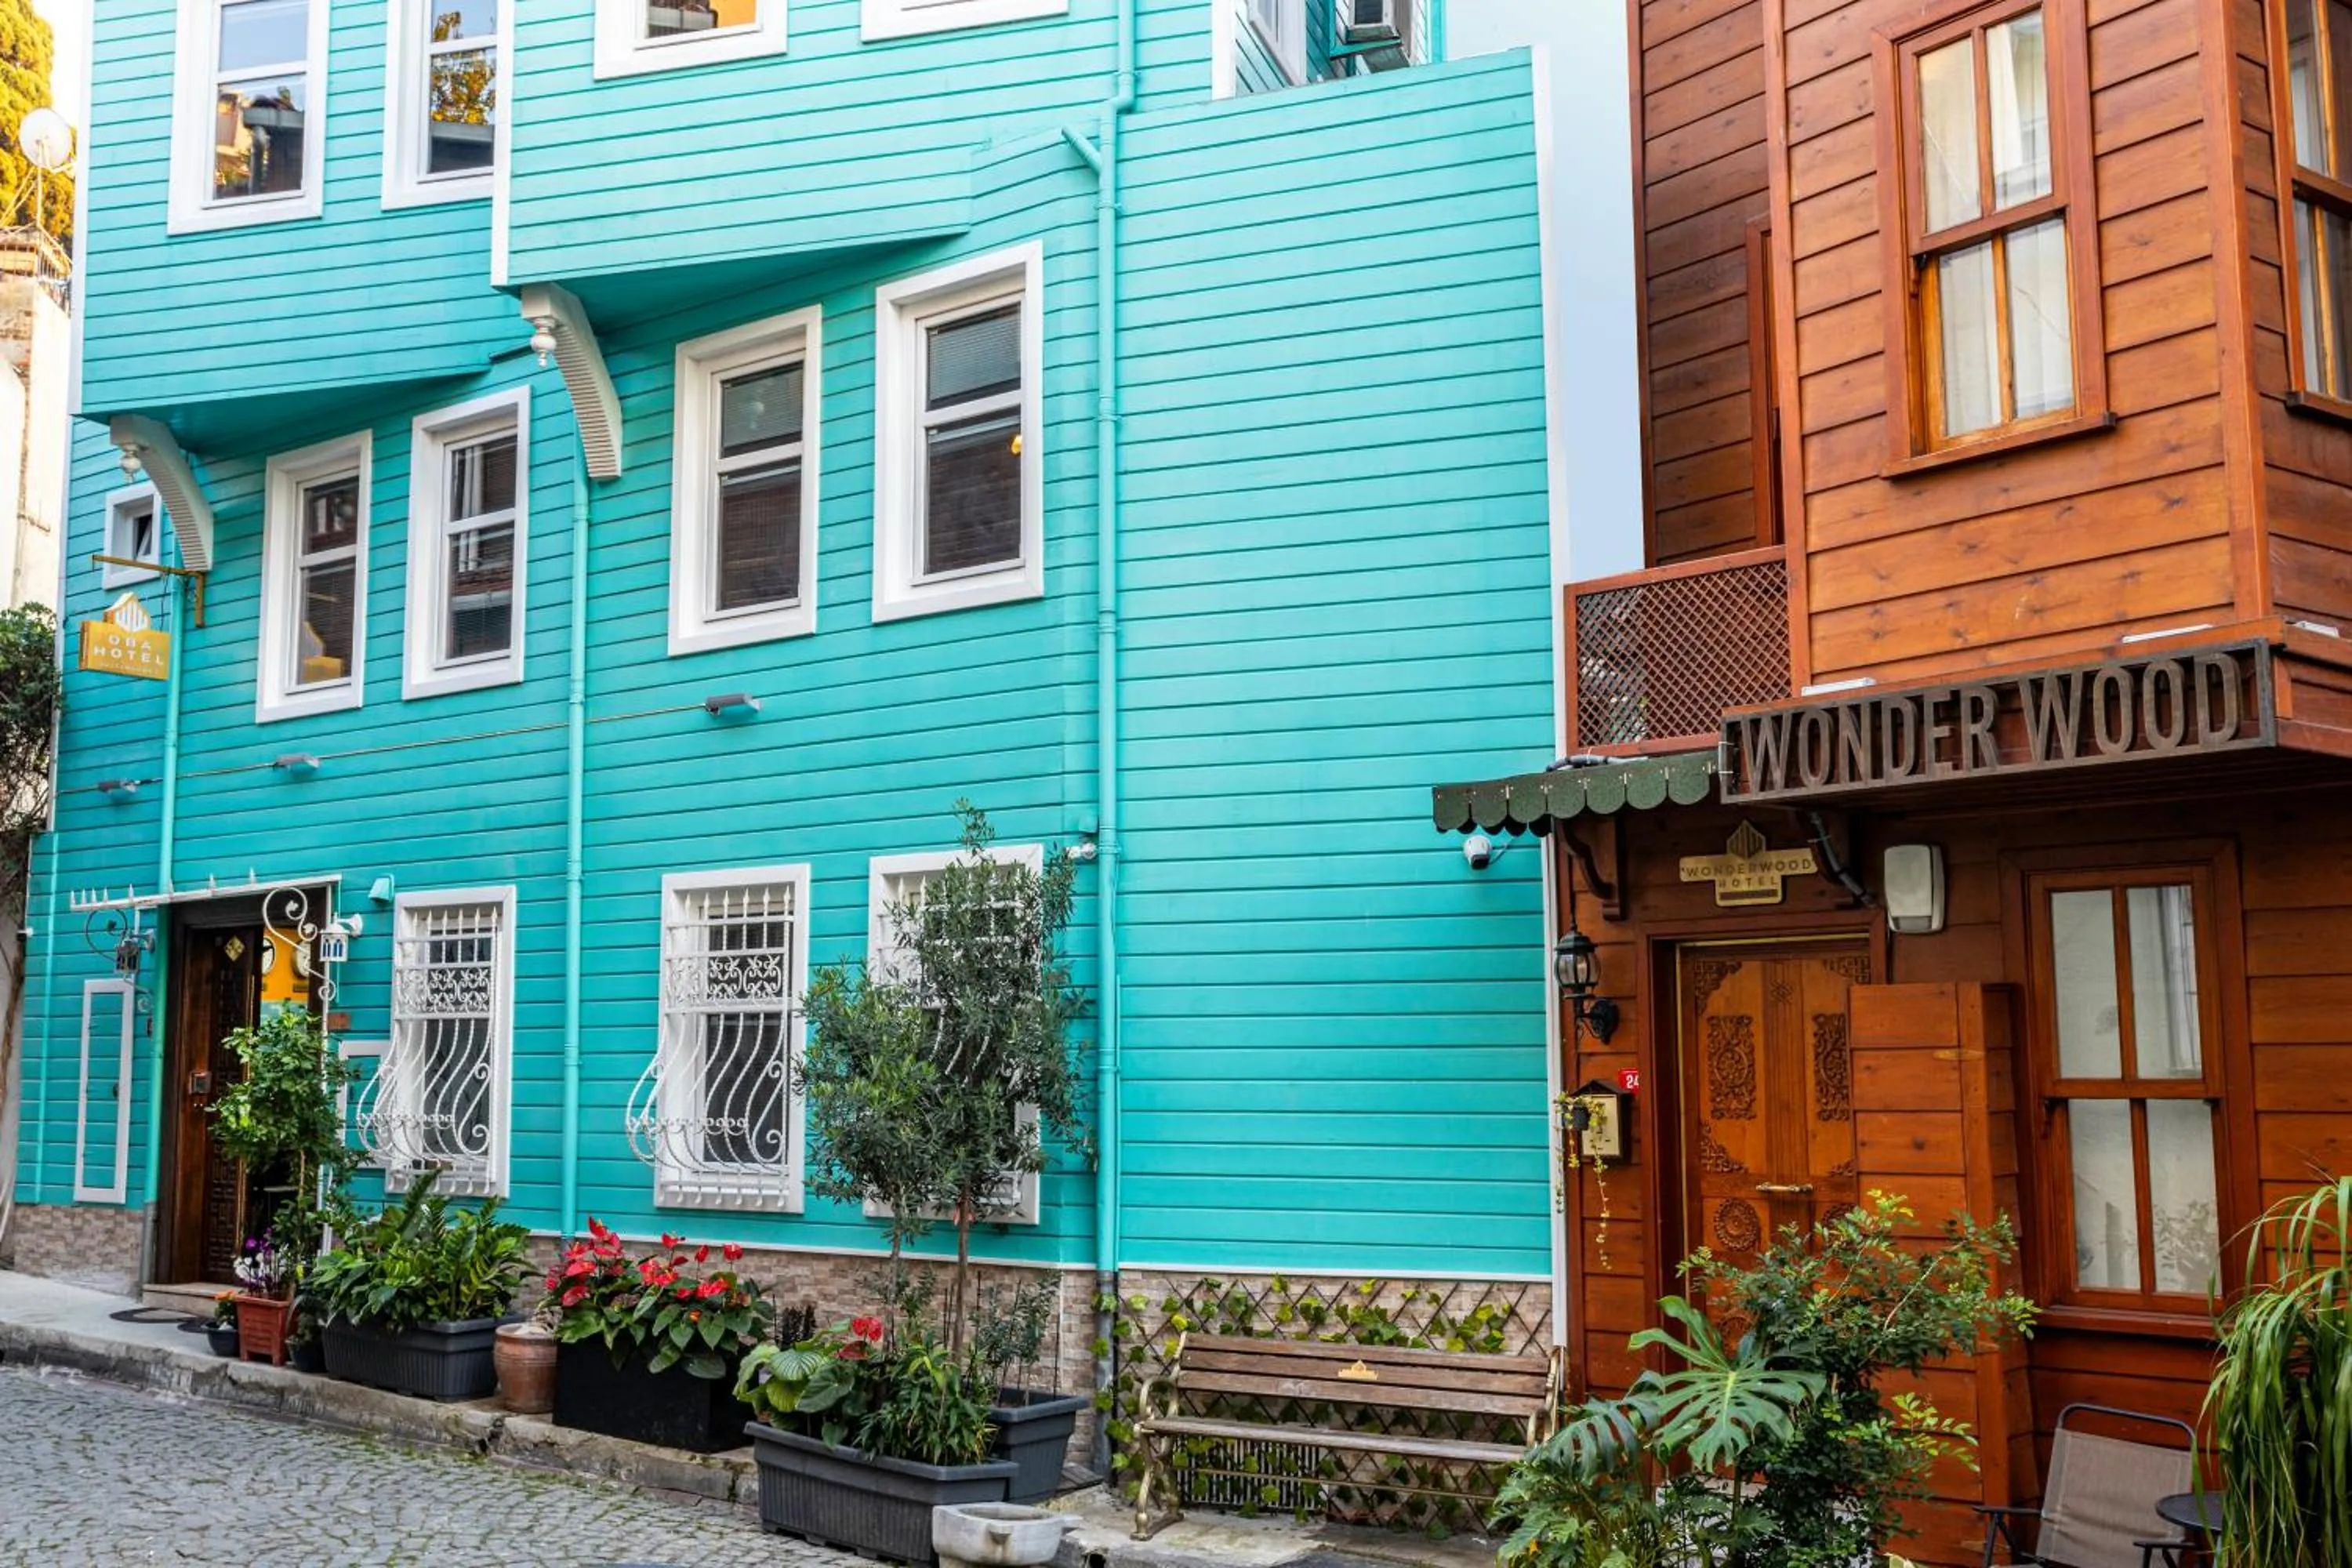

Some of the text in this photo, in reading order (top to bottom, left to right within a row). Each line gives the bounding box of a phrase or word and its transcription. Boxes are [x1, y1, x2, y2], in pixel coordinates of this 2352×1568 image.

[108, 634, 151, 651] OBA
[93, 644, 164, 666] HOTEL
[1740, 652, 2241, 793] WONDER WOOD
[1686, 858, 1813, 877] WONDERWOOD
[1719, 876, 1779, 888] HOTEL
[1625, 1074, 1639, 1089] 24
